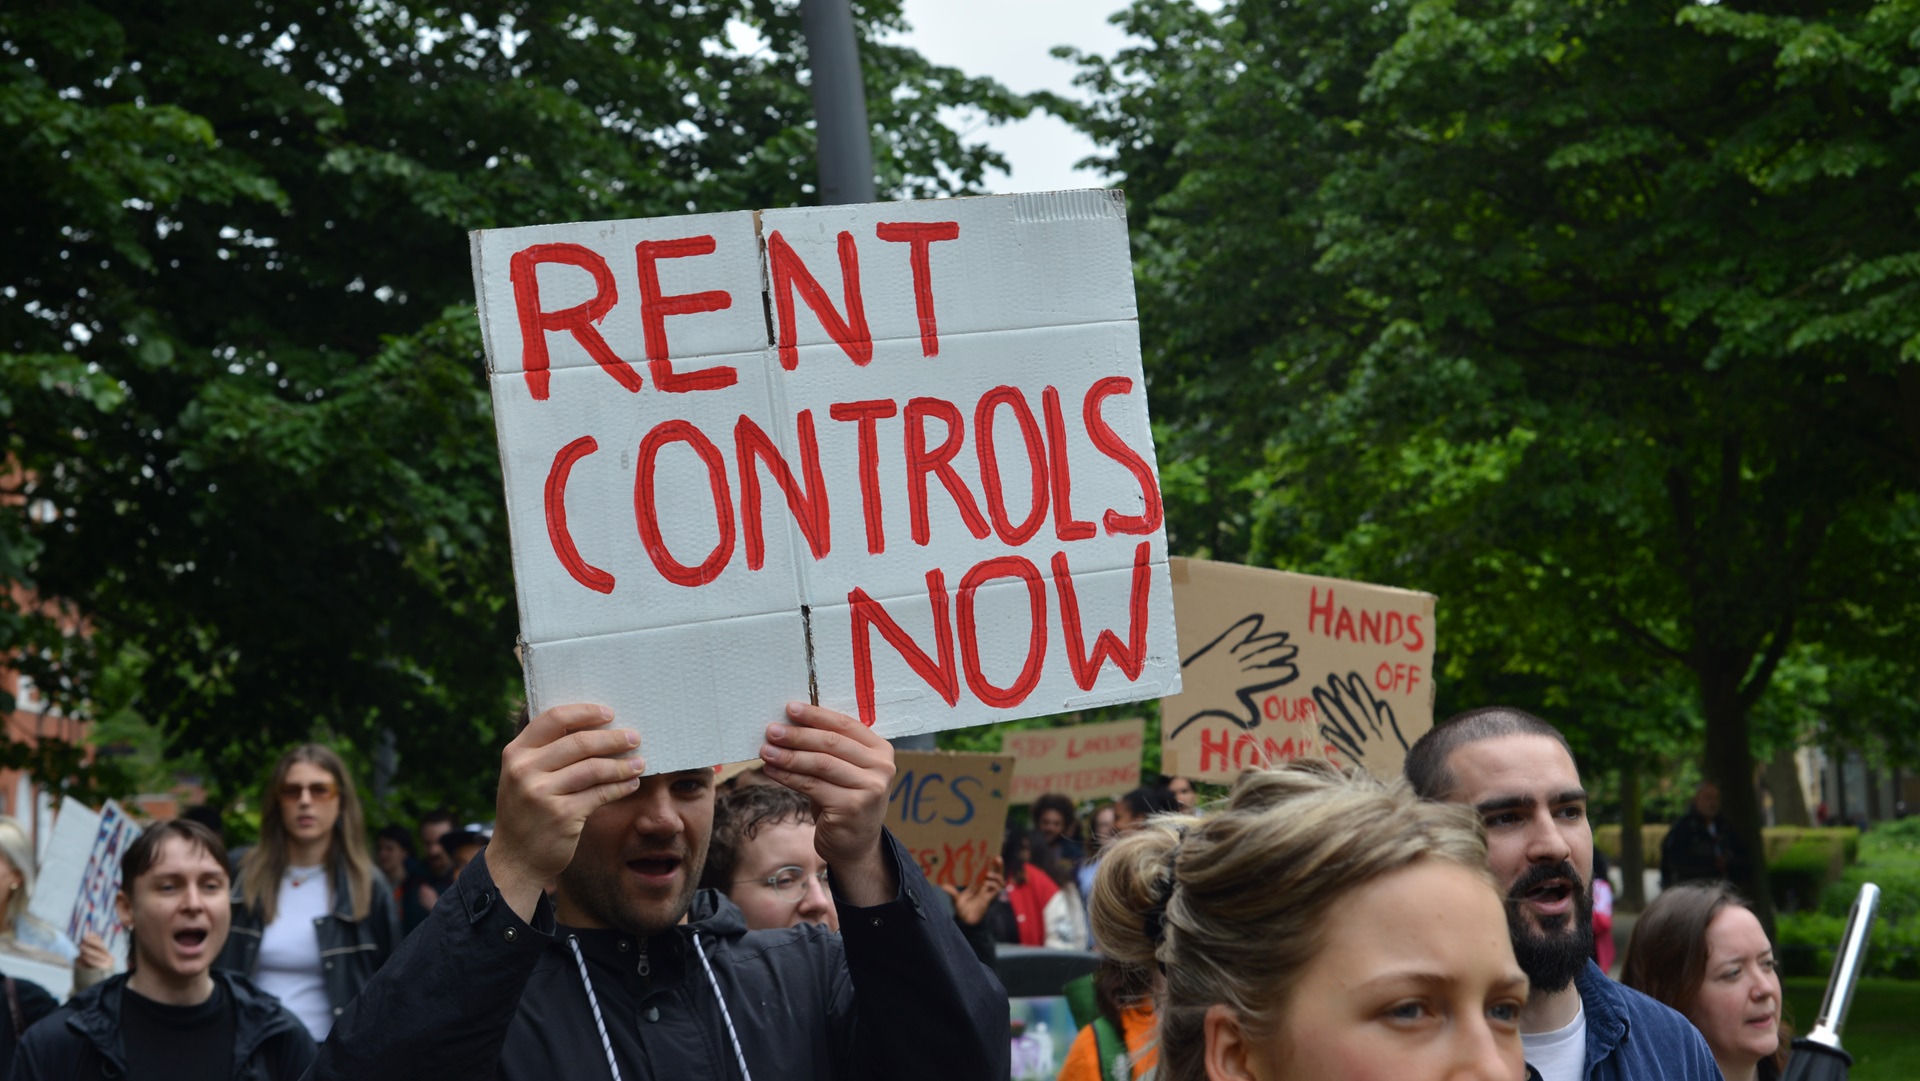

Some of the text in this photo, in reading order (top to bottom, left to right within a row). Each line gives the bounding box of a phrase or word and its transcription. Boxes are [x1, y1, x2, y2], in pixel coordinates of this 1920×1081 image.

[510, 222, 959, 401] RENT
[545, 376, 1163, 594] CONTROLS
[848, 542, 1151, 728] NOW
[1308, 585, 1425, 653] HANDS
[1263, 694, 1318, 723] OUR
[1375, 661, 1422, 696] OFF
[1009, 735, 1057, 761] STOP
